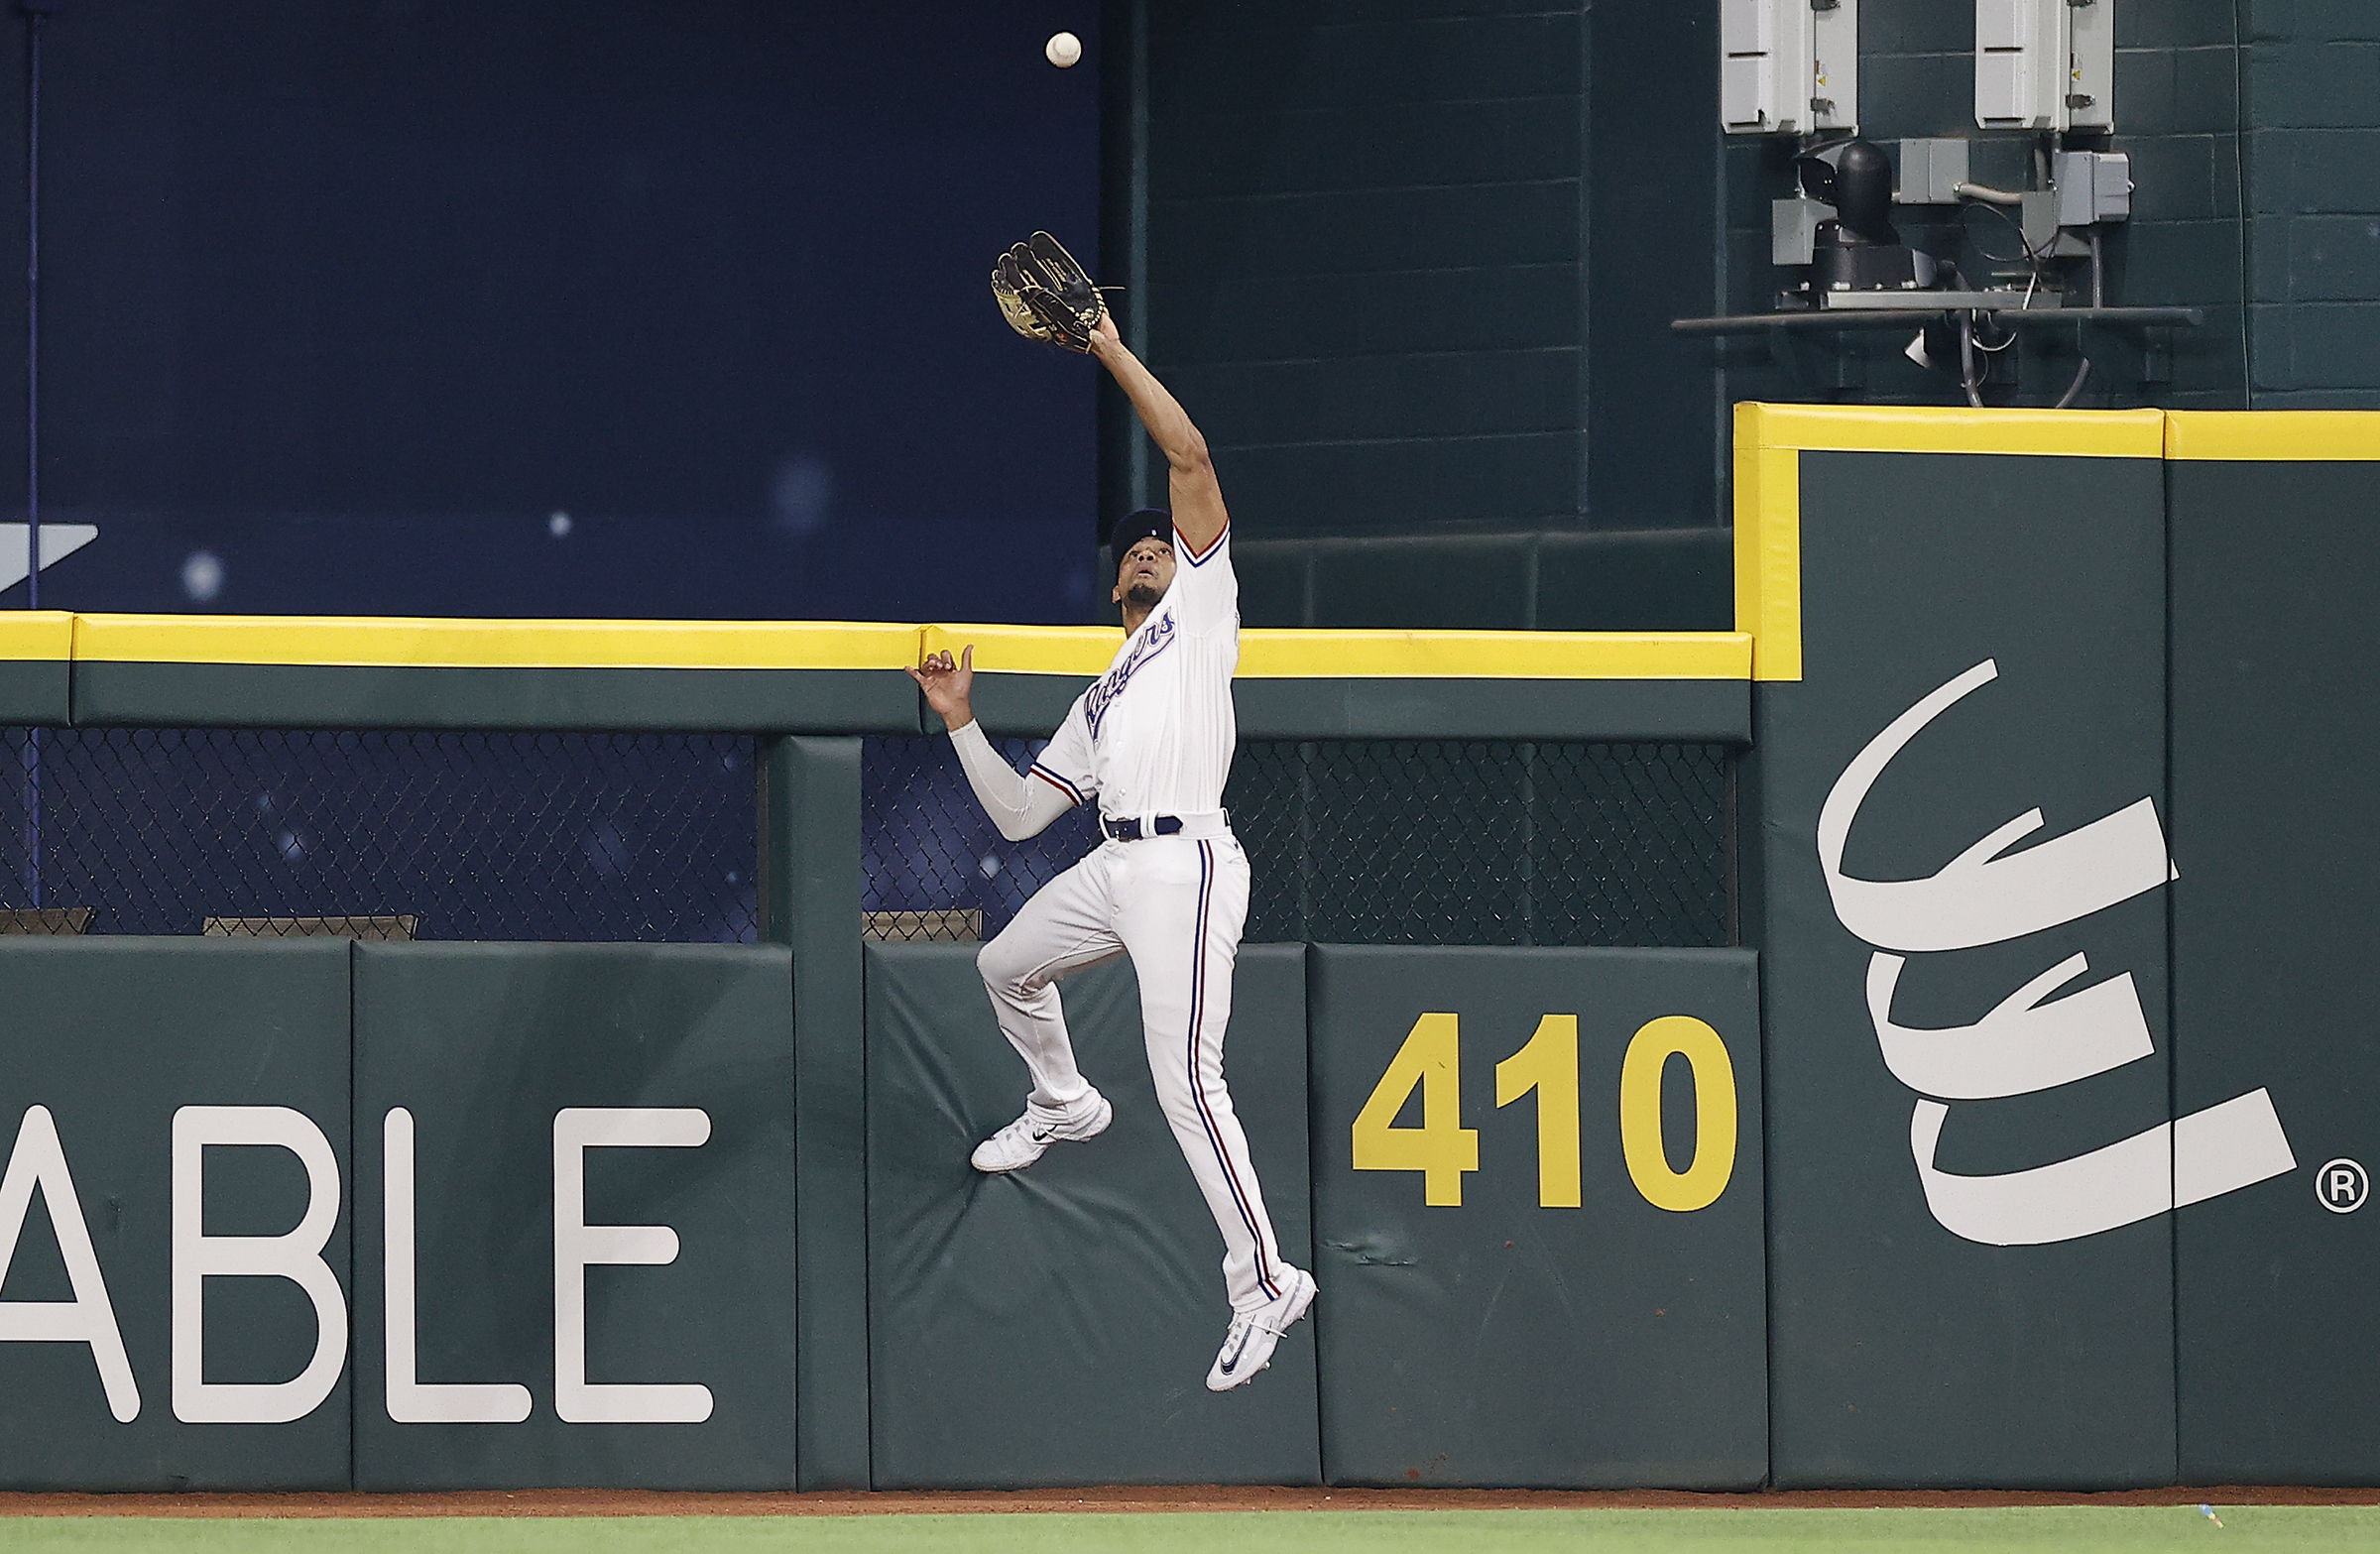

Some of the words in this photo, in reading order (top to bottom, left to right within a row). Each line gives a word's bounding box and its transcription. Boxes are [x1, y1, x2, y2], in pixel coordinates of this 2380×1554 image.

[1084, 607, 1175, 742] Rangers
[1352, 1013, 1737, 1212] 410
[0, 1104, 714, 1424] ABLE
